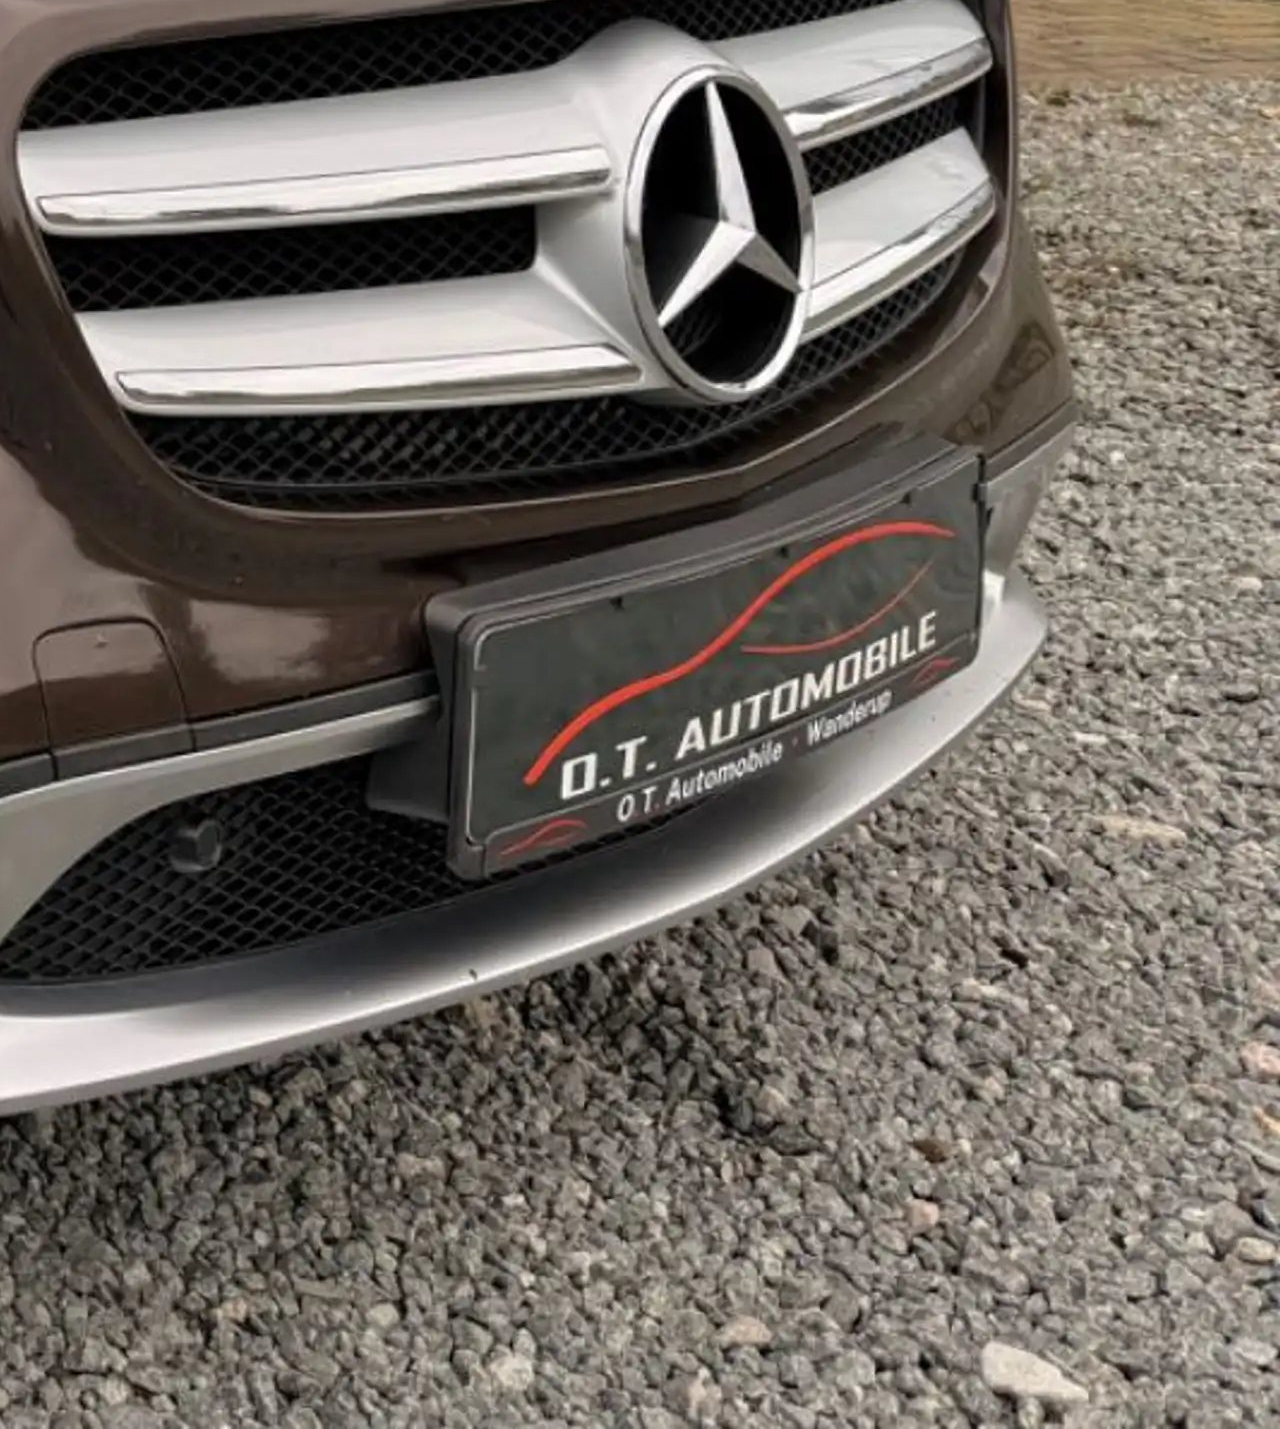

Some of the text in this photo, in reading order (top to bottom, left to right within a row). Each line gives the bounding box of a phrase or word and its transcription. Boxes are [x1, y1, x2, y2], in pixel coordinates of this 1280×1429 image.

[559, 610, 939, 801] O.T. AUTOMOBILE
[665, 739, 783, 806] Automobile
[806, 688, 894, 746] Wanderup
